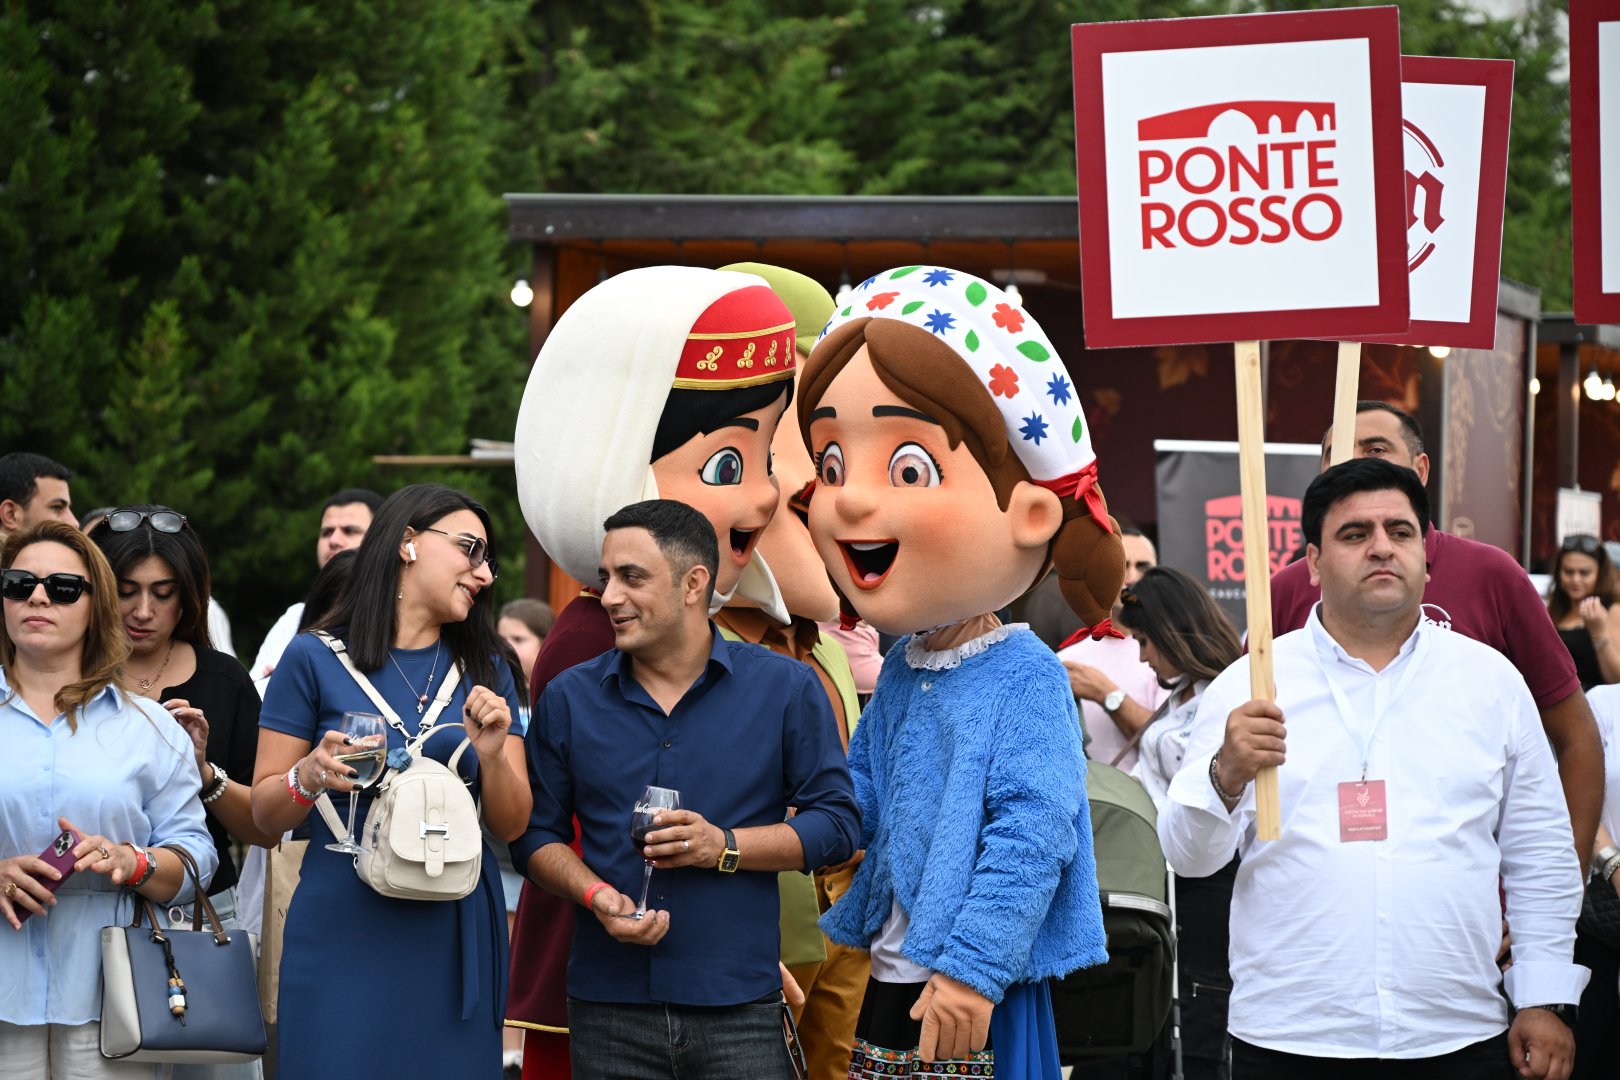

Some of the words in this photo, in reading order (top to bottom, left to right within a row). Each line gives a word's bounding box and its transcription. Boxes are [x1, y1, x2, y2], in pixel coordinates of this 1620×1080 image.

[1138, 139, 1339, 197] PONTE
[1142, 193, 1343, 250] ROSSO
[1206, 518, 1302, 550] POTE
[1208, 550, 1295, 581] ROS
